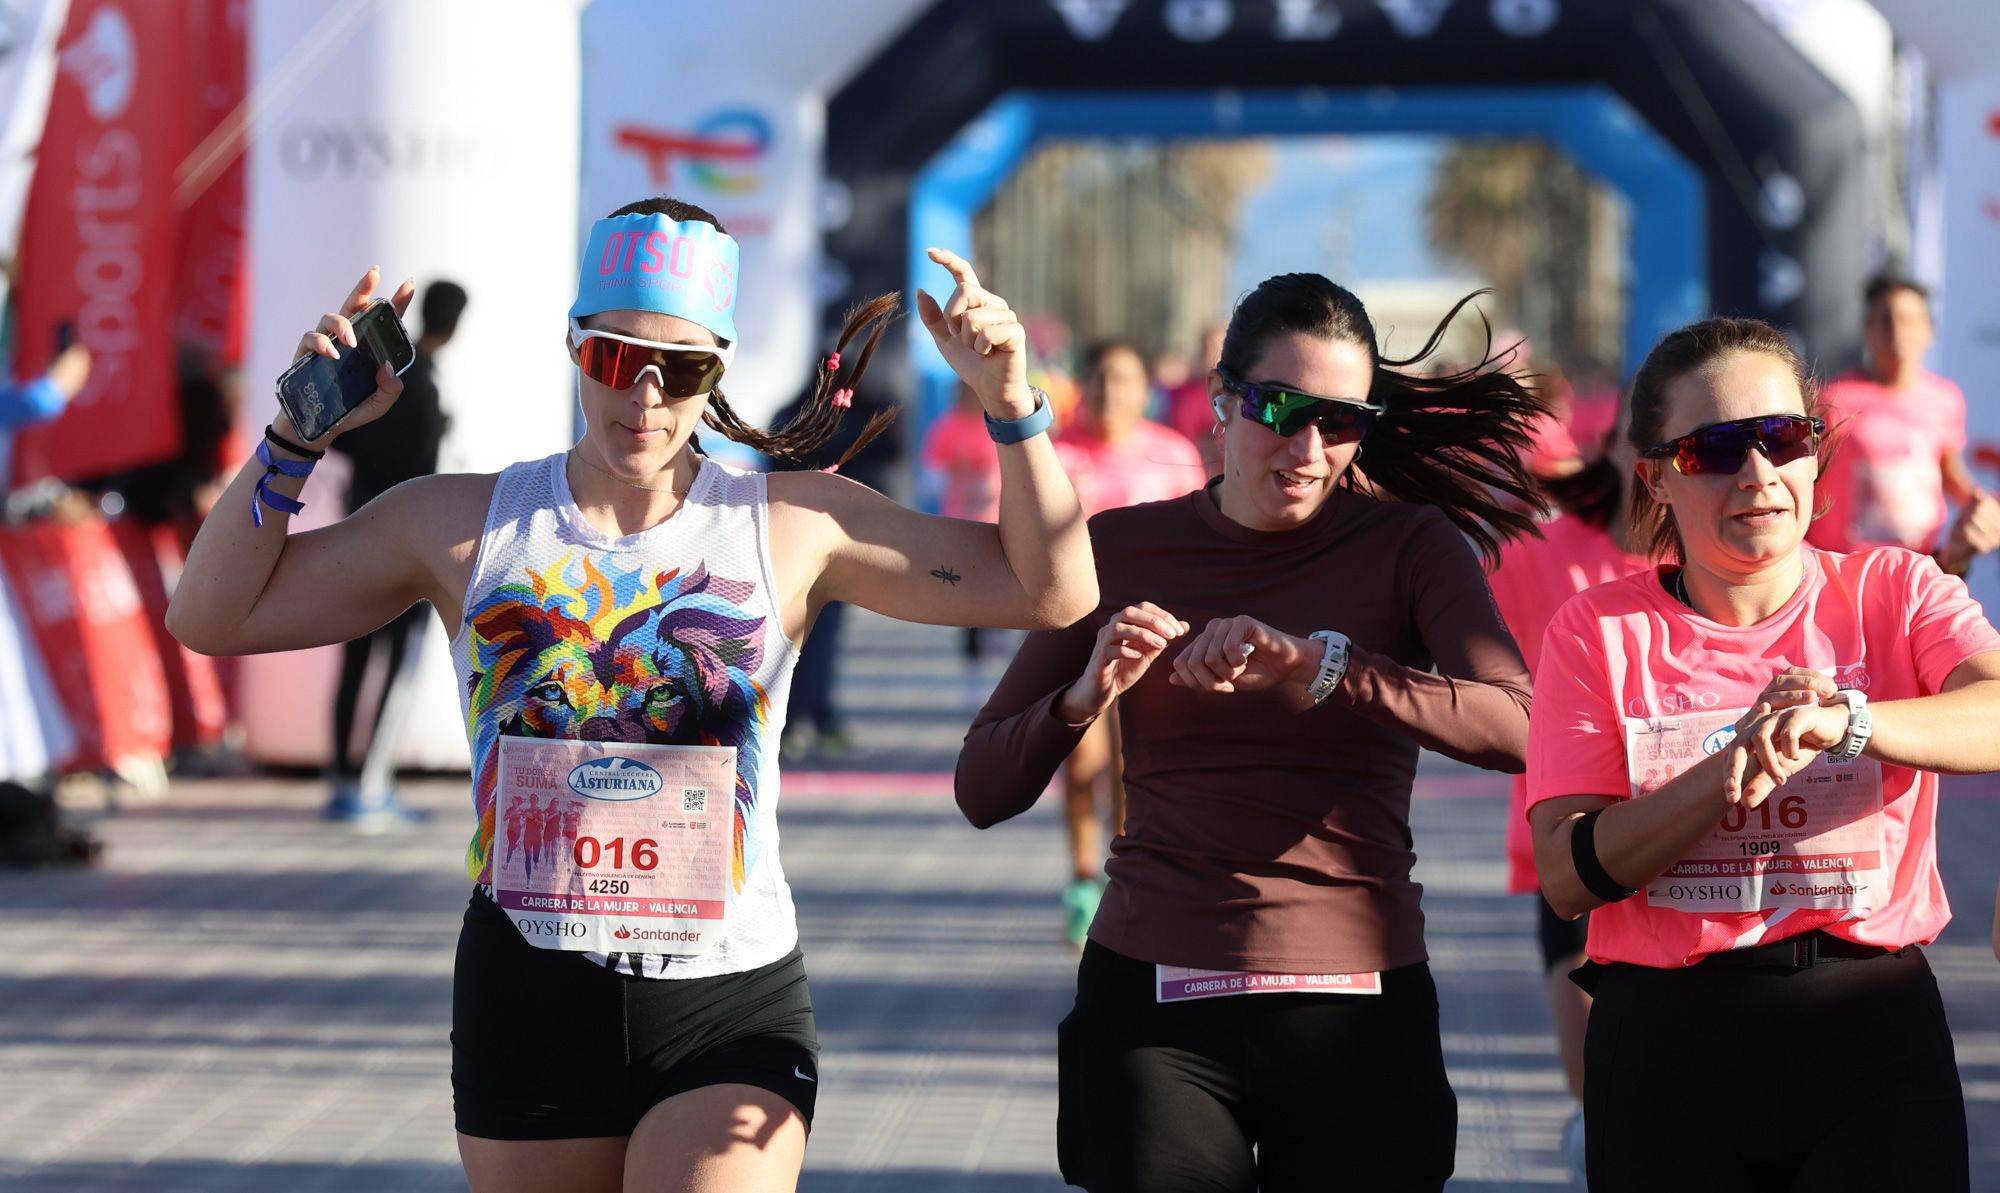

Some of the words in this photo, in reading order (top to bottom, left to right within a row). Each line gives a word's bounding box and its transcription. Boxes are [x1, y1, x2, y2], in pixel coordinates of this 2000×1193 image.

[599, 231, 695, 279] OTSO
[599, 278, 633, 290] THINK
[303, 382, 325, 415] 9:33
[1628, 691, 1720, 718] OYSHO
[1648, 748, 1694, 761] SUMA
[514, 767, 526, 775] TU
[527, 768, 558, 777] DORSAL
[589, 770, 621, 778] CENTRAL
[515, 776, 558, 790] SUMA
[574, 772, 656, 791] ASTURIANA
[1720, 795, 1808, 833] 016
[573, 836, 659, 871] 016
[1738, 840, 1781, 856] 1909
[1670, 862, 1718, 875] CARRERA
[1722, 862, 1735, 873] DE
[1739, 861, 1753, 873] LA
[1756, 860, 1793, 872] MUJER
[1802, 857, 1854, 870] VALENCIA
[589, 879, 630, 895] 4250
[1669, 885, 1741, 900] OYSHO
[1789, 882, 1858, 897] Santander
[521, 896, 567, 910] CARRERA
[571, 899, 585, 910] DE
[588, 900, 601, 912] LA
[604, 901, 639, 913] MUJER
[649, 903, 698, 915] VALENCIA
[518, 918, 586, 938] OYSHO
[633, 927, 701, 942] Santander
[1184, 981, 1227, 994] CARRERA
[1230, 978, 1242, 989] DE
[1246, 977, 1258, 987] LA
[1261, 974, 1296, 986] MUJER
[1305, 974, 1352, 985] VALENCIA
